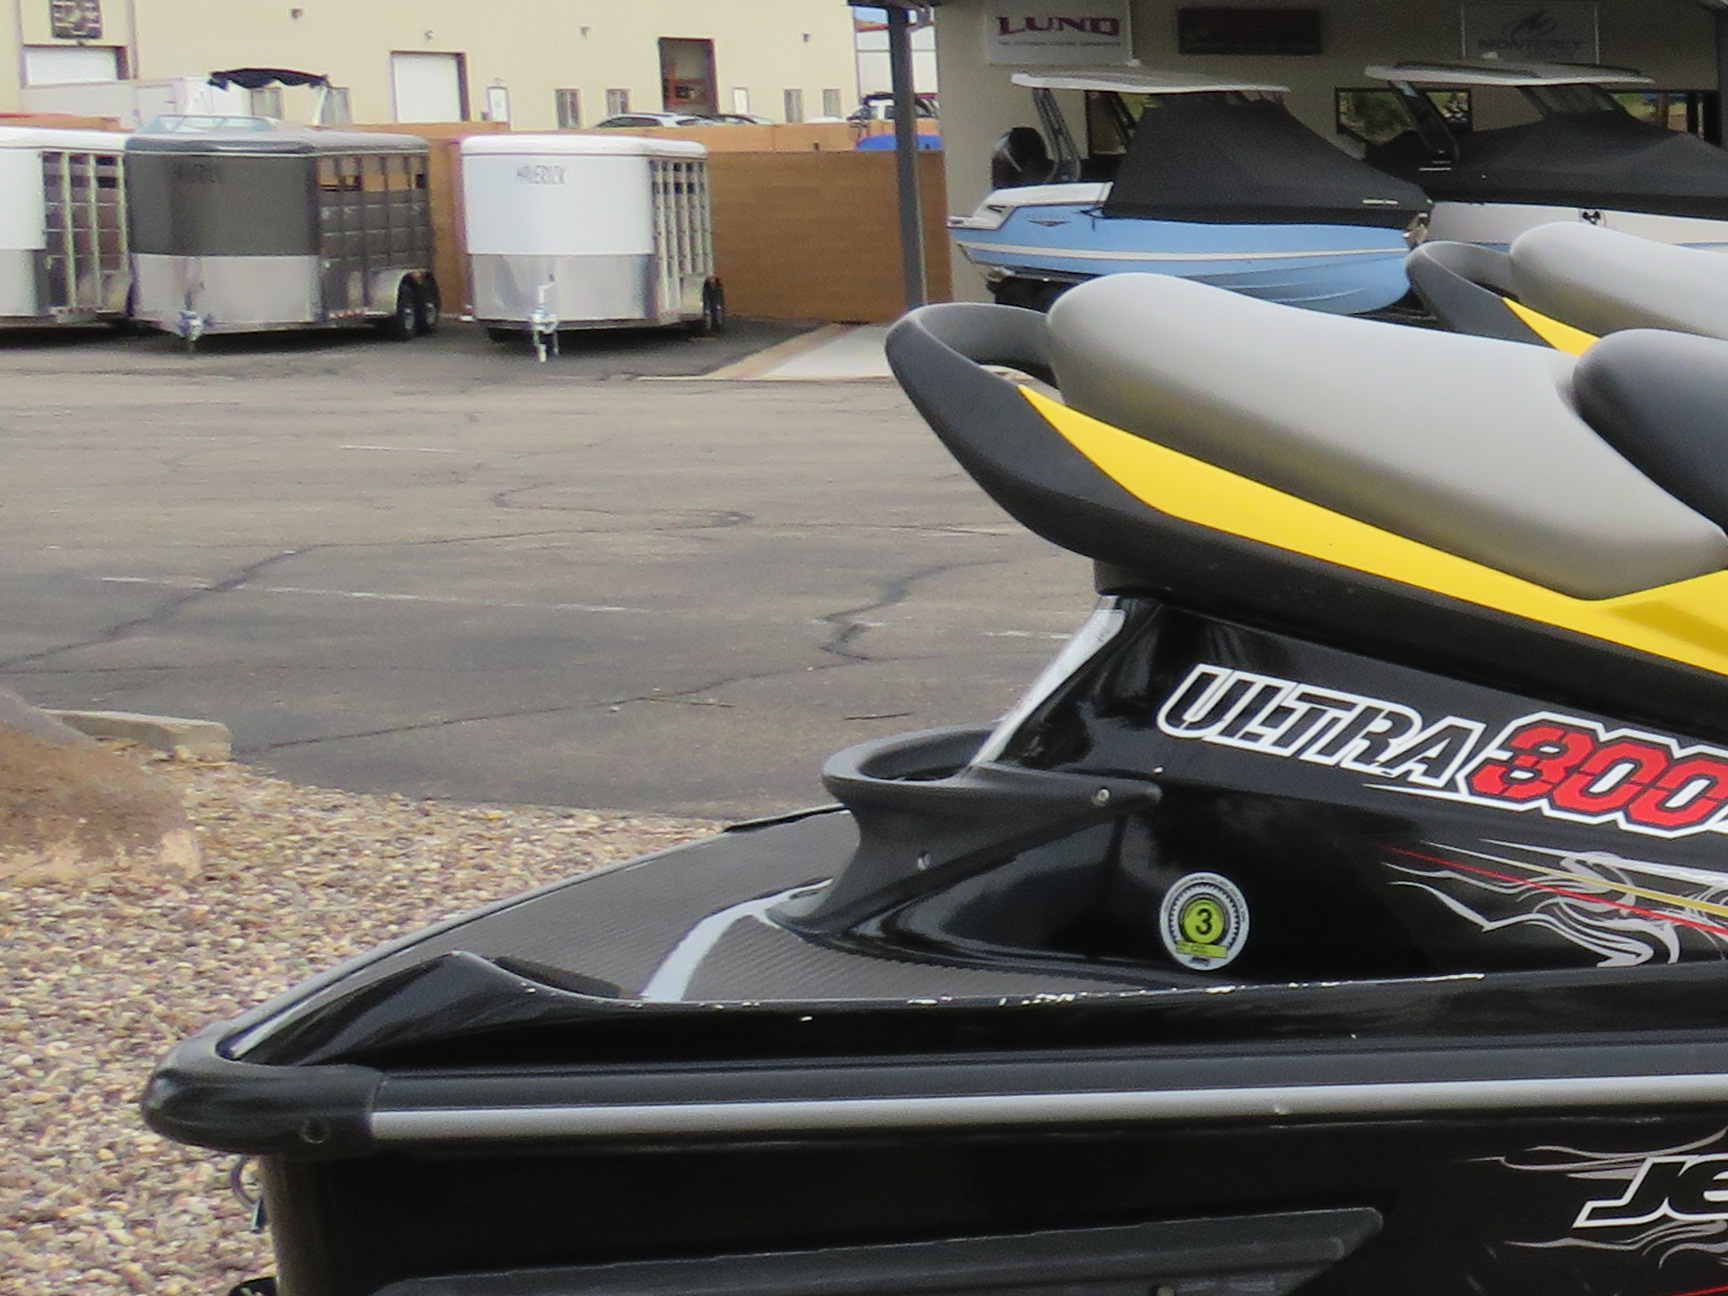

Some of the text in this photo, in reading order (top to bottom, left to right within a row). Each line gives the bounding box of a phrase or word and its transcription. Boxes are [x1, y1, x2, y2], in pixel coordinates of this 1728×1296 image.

[996, 16, 1120, 37] LUND
[1157, 664, 1487, 786] ULTRA
[1196, 908, 1212, 935] 3
